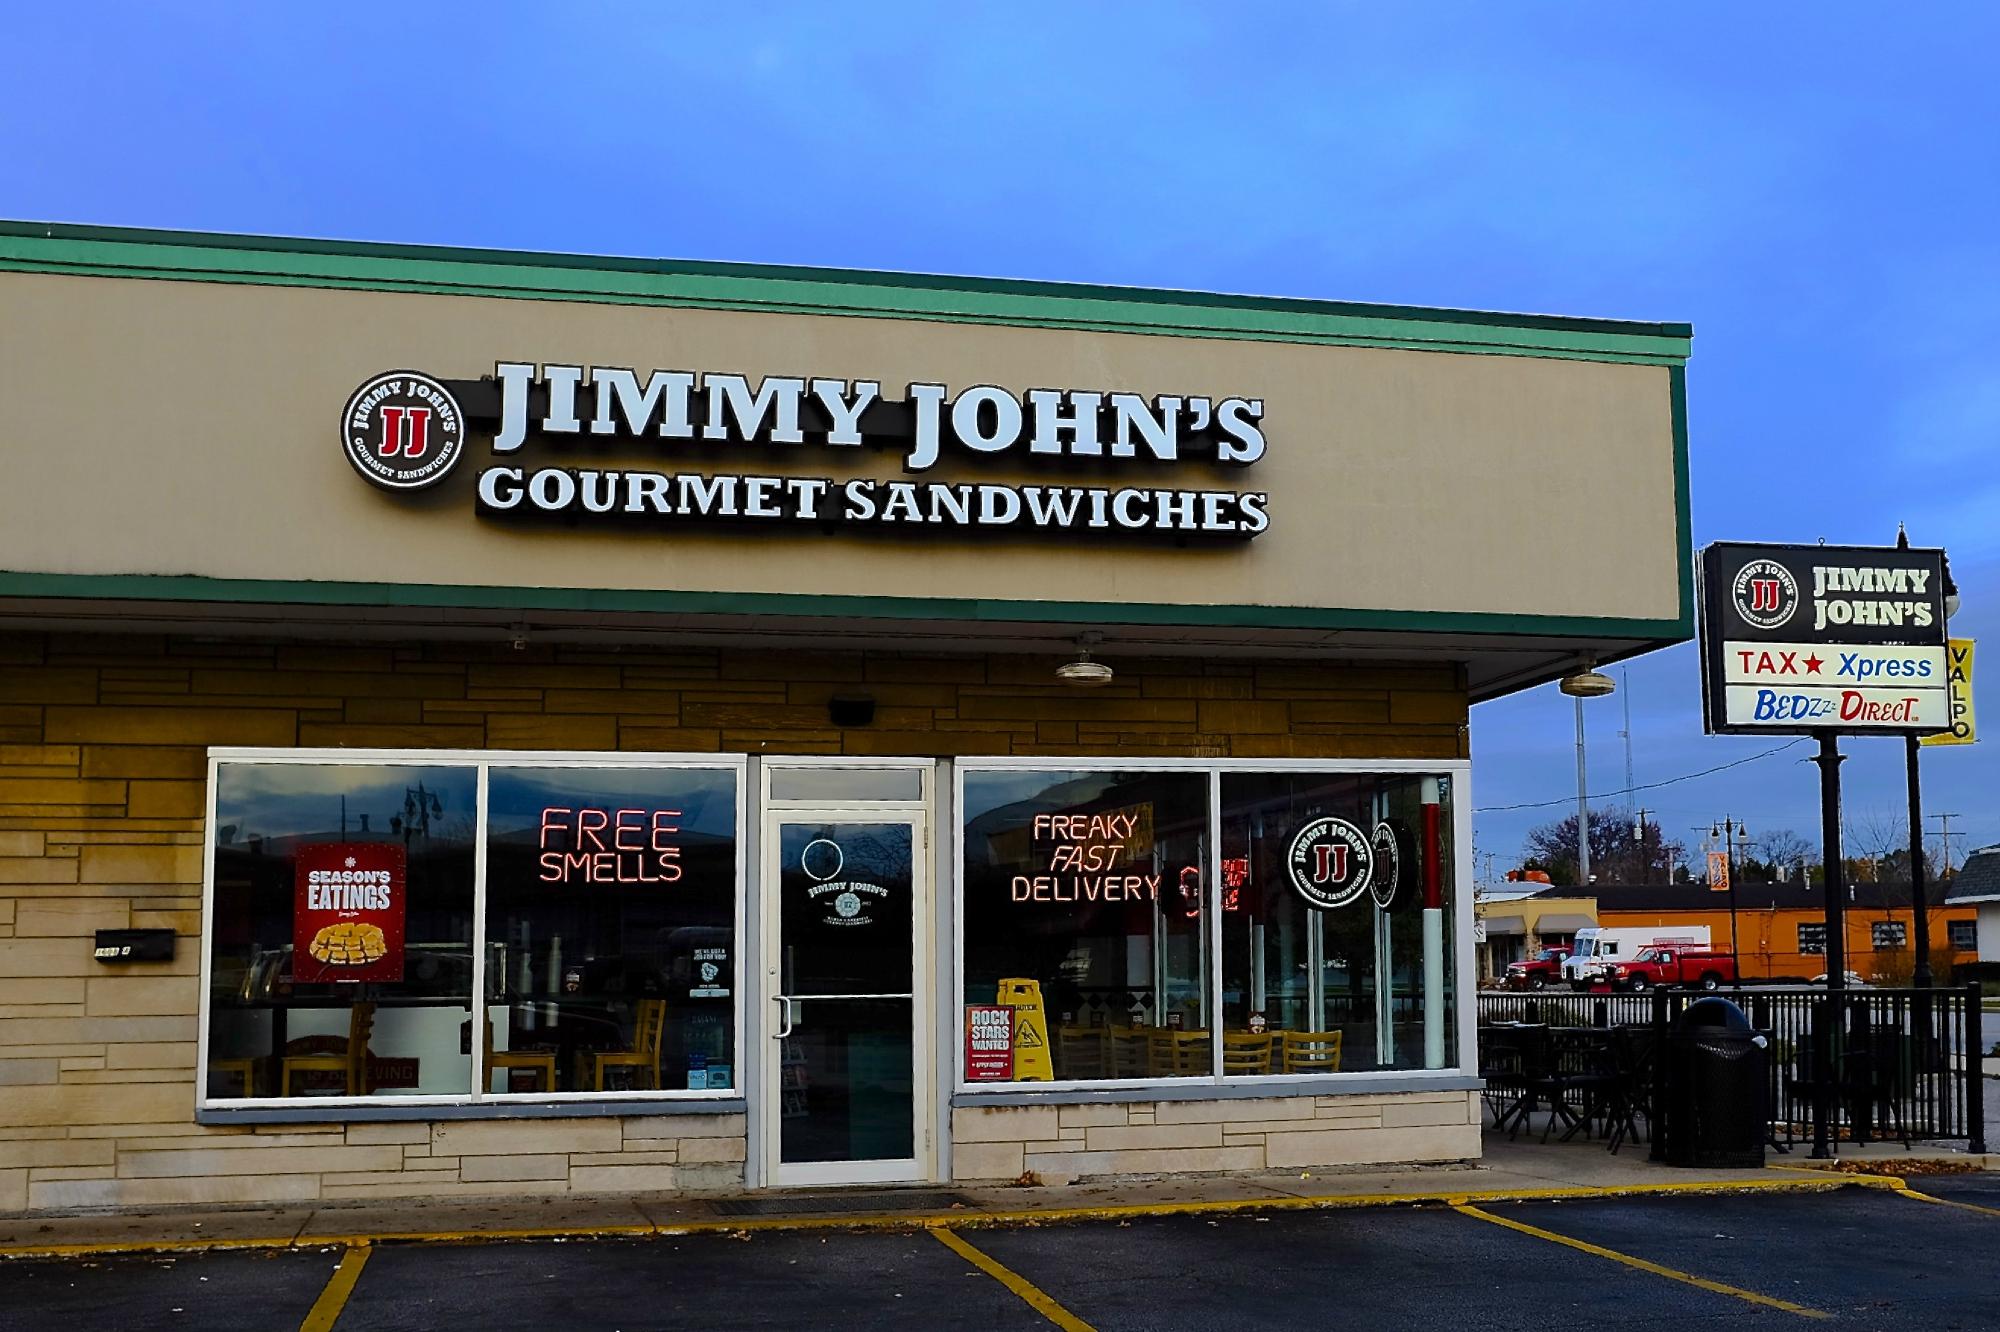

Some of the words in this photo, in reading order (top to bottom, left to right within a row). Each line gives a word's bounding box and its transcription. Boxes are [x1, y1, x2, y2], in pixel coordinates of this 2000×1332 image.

[353, 381, 402, 430] JIMMY
[407, 382, 456, 434] JOHN'S
[494, 363, 879, 451] JIMMY
[908, 382, 1265, 469] JOHN'S
[378, 406, 431, 458] JJ
[354, 437, 395, 477] GOURMET
[397, 440, 454, 479] SANDWICHES
[478, 468, 827, 519] GOURMET
[845, 481, 1268, 532] SANDWICHES
[1737, 564, 1762, 594] JIMMY
[1765, 564, 1794, 596] JOHN'S
[1751, 579, 1780, 612] JJ
[1812, 566, 1930, 597] JIMMY
[1813, 600, 1932, 631] JOHN'S
[1737, 651, 1799, 676] TAX
[1836, 652, 1933, 682] Xpress
[540, 808, 682, 852] FREE
[1033, 814, 1138, 840] FREAKY
[1295, 823, 1327, 863] JIMMY
[1331, 823, 1367, 863] JOHN'S
[539, 852, 683, 883] SMELLS
[1050, 845, 1125, 873] FAST
[1313, 844, 1348, 883] JJ
[308, 870, 391, 884] SEASON'S
[807, 881, 847, 899] JIMMY
[848, 881, 888, 898] JOHN'S
[1011, 875, 1161, 902] DELIVERY
[307, 884, 391, 910] EATINGS
[971, 1010, 1010, 1025] ROCK
[971, 1026, 1010, 1040] STARS
[971, 1040, 1010, 1051] WANTED
